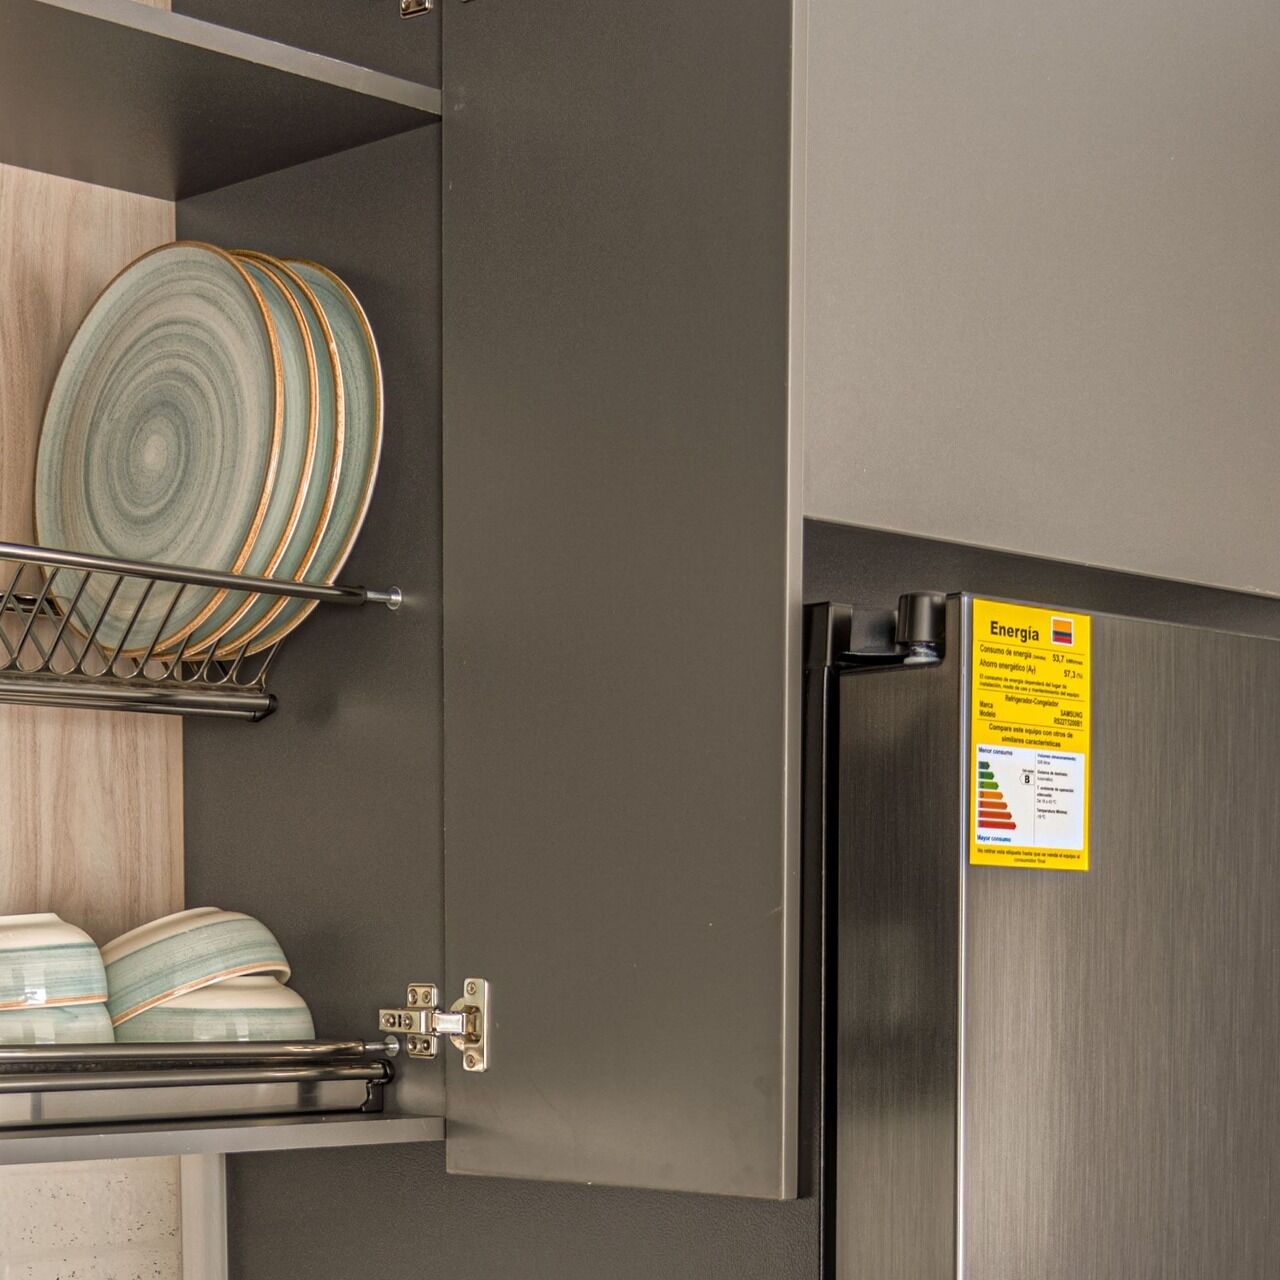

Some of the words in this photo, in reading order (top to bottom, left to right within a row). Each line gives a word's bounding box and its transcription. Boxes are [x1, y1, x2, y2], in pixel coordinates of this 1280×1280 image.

[990, 620, 1040, 643] Energía
[980, 644, 1004, 654] Consumo
[1005, 648, 1012, 656] de
[1013, 650, 1032, 660] energía
[1052, 654, 1064, 664] 53,7
[980, 658, 998, 668] Ahorro
[998, 660, 1025, 672] energético
[1064, 670, 1076, 680] 57,3
[979, 700, 993, 709] Marca
[1005, 694, 1059, 709] Refrigerador-Congelador
[979, 709, 996, 718] Modelo
[1060, 709, 1083, 719] SAMSUNG
[989, 723, 1012, 733] Compare
[1025, 727, 1042, 736] equipo
[1053, 730, 1066, 738] otros
[1001, 736, 1024, 744] similares
[1025, 738, 1061, 748] características
[1024, 774, 1030, 784] B
[977, 834, 990, 842] Mayor
